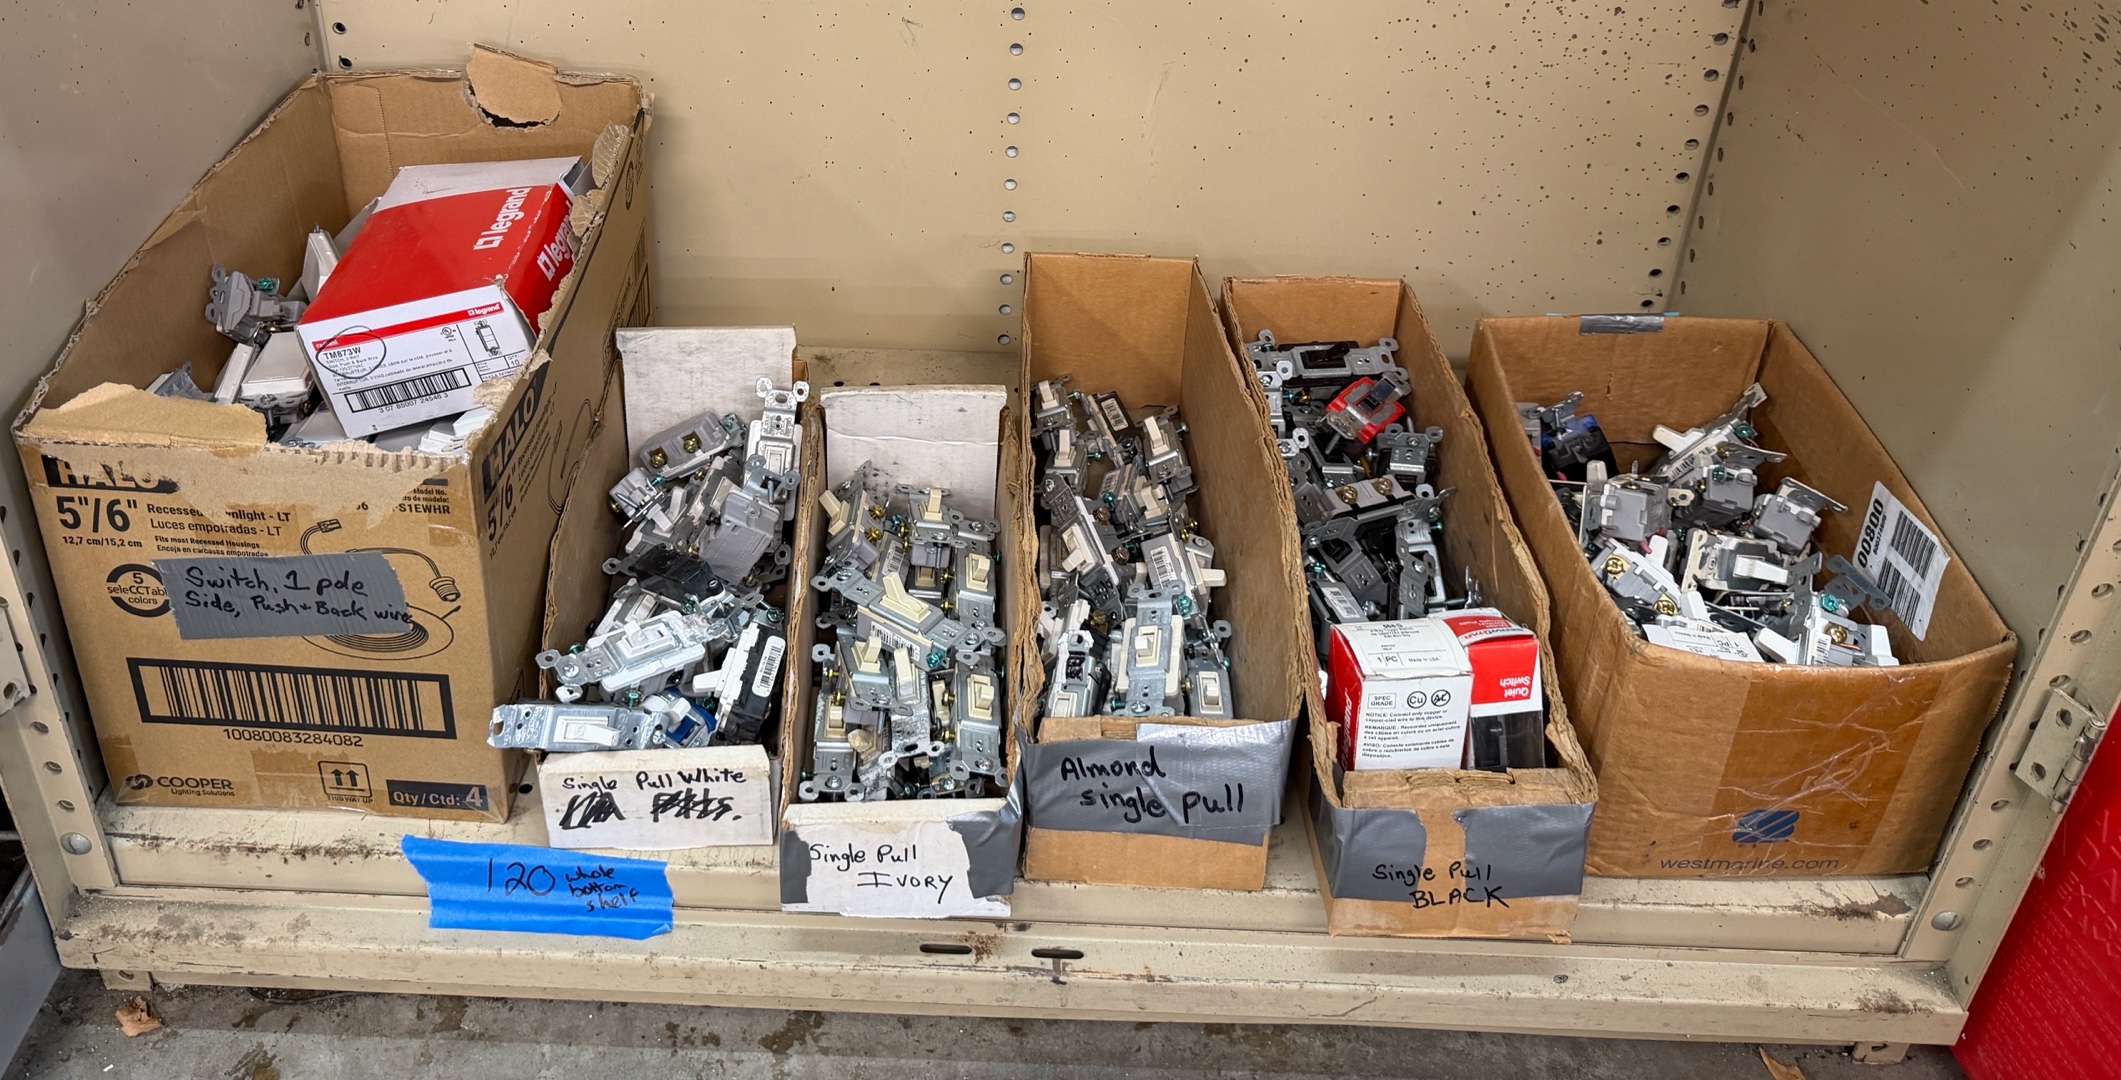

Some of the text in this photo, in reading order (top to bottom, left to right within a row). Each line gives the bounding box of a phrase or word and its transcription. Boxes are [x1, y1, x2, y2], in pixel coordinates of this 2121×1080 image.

[481, 187, 532, 236] legrand
[543, 199, 573, 268] legra
[474, 302, 501, 316] legrand
[316, 339, 339, 350] raant
[323, 346, 361, 360] TM873W
[421, 394, 442, 404] 24546
[490, 388, 537, 489] HALO
[413, 487, 448, 496] Model No.
[422, 495, 449, 504] modelo:
[393, 503, 451, 514] S1EWHR
[278, 512, 291, 522] LT
[150, 518, 185, 531] Luces
[188, 522, 258, 536] empotradas
[267, 526, 282, 537] LT
[1858, 497, 1885, 569] 00800
[63, 536, 143, 549] 12,7 cm/15,2 cm
[155, 535, 169, 543] Fits
[190, 537, 225, 547] Recessed
[226, 539, 260, 549] Housings
[157, 545, 181, 553] Encoja
[133, 572, 144, 584] 5
[283, 569, 310, 591] 1
[316, 570, 368, 597] pole
[107, 585, 168, 597] seleCCTabl
[128, 596, 158, 604] colors
[185, 590, 241, 619] Side,
[250, 595, 299, 615] Push
[315, 600, 368, 621] Back
[373, 607, 415, 625] wire
[1717, 639, 1729, 647] PC
[1499, 675, 1531, 687] Switch
[1505, 687, 1530, 697] Quiet
[1409, 695, 1424, 704] Cu
[223, 728, 364, 747] 10080083284082
[1060, 745, 1167, 781] Almond
[157, 775, 233, 790] COOPER
[563, 768, 748, 798] Single Pull White
[171, 787, 235, 797] Lighting Solutions
[392, 790, 418, 806] Qty
[431, 793, 461, 807] Ctd:
[465, 786, 484, 808] 4
[1079, 786, 1166, 824] single
[809, 842, 918, 873] Single Pull
[1660, 857, 1840, 871] westmarine.com
[487, 857, 616, 897] 120 whole
[1371, 862, 1493, 888] Single Pull
[569, 882, 628, 899] bottom
[585, 889, 640, 914] shelf
[1409, 885, 1511, 911] BLACK
